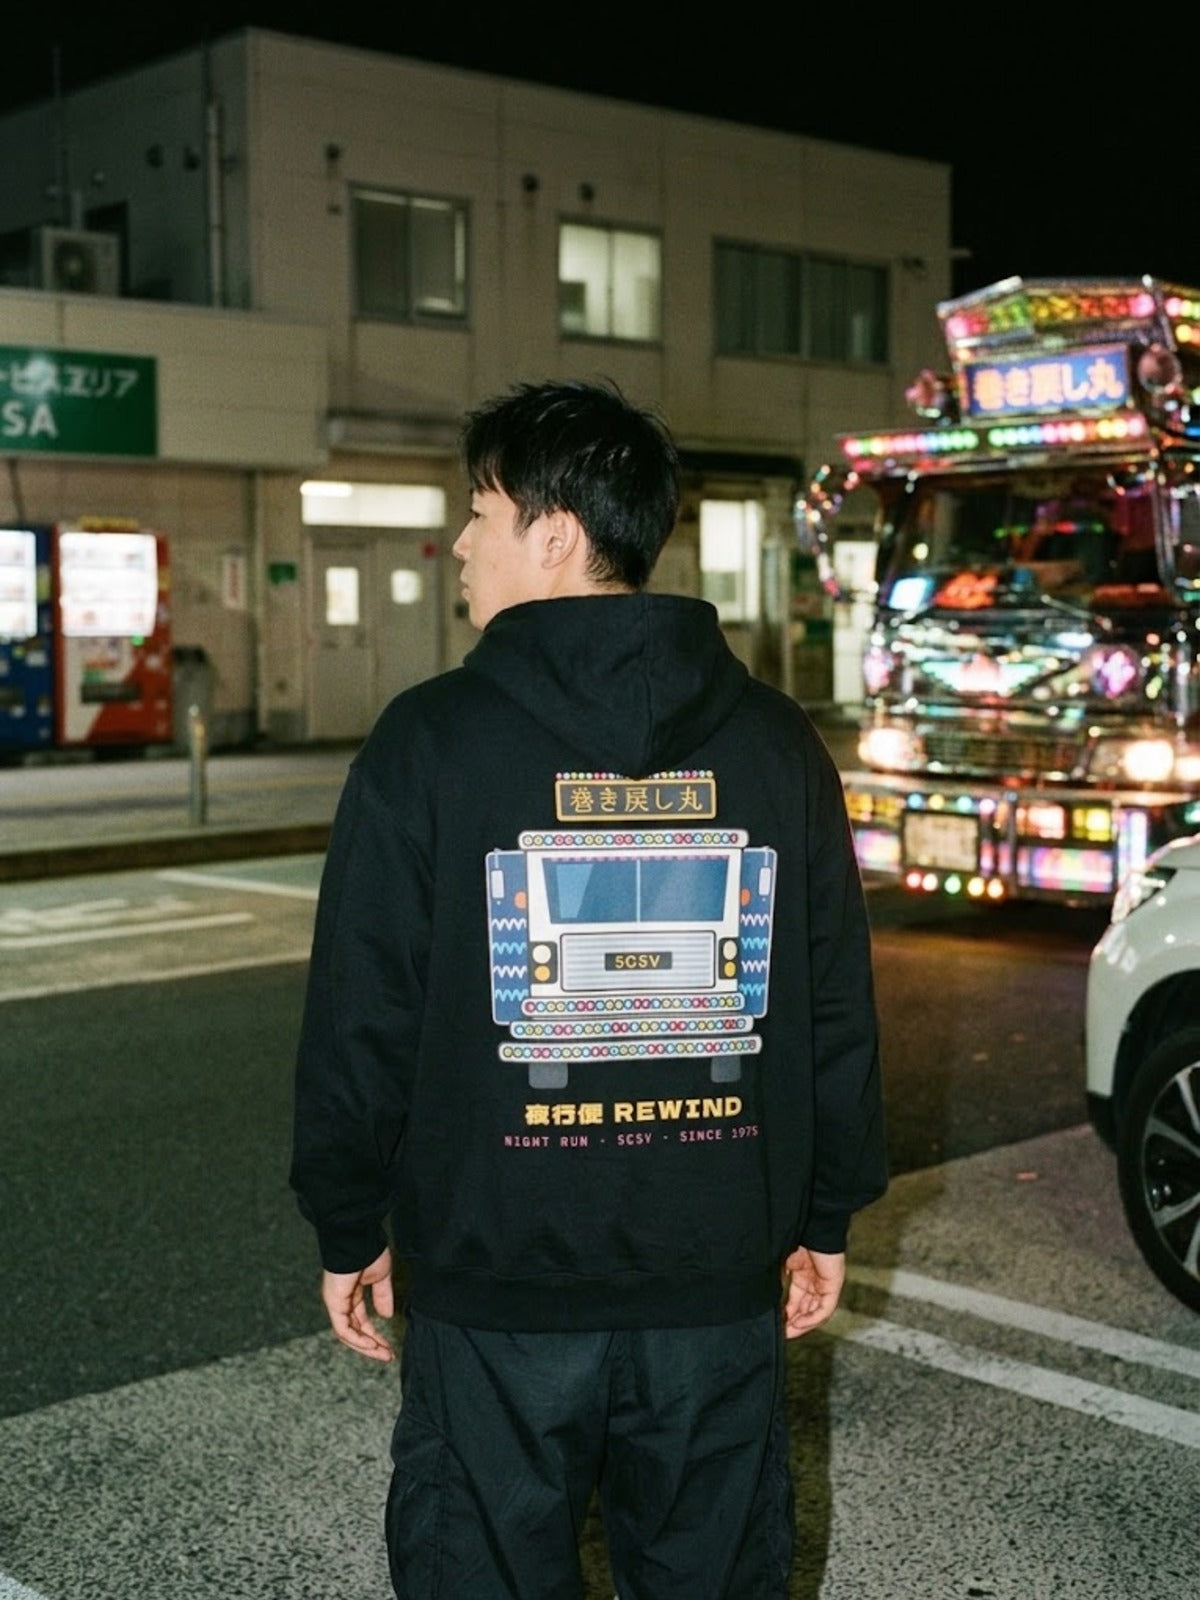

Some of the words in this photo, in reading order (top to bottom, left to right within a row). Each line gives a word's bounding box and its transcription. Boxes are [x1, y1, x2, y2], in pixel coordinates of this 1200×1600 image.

[2, 401, 58, 438] SA
[570, 785, 703, 813] 巻き戻し丸
[614, 1096, 743, 1123] REWIND
[560, 1136, 588, 1147] RUN
[617, 1132, 652, 1146] SCSV
[680, 1129, 722, 1142] SINCE
